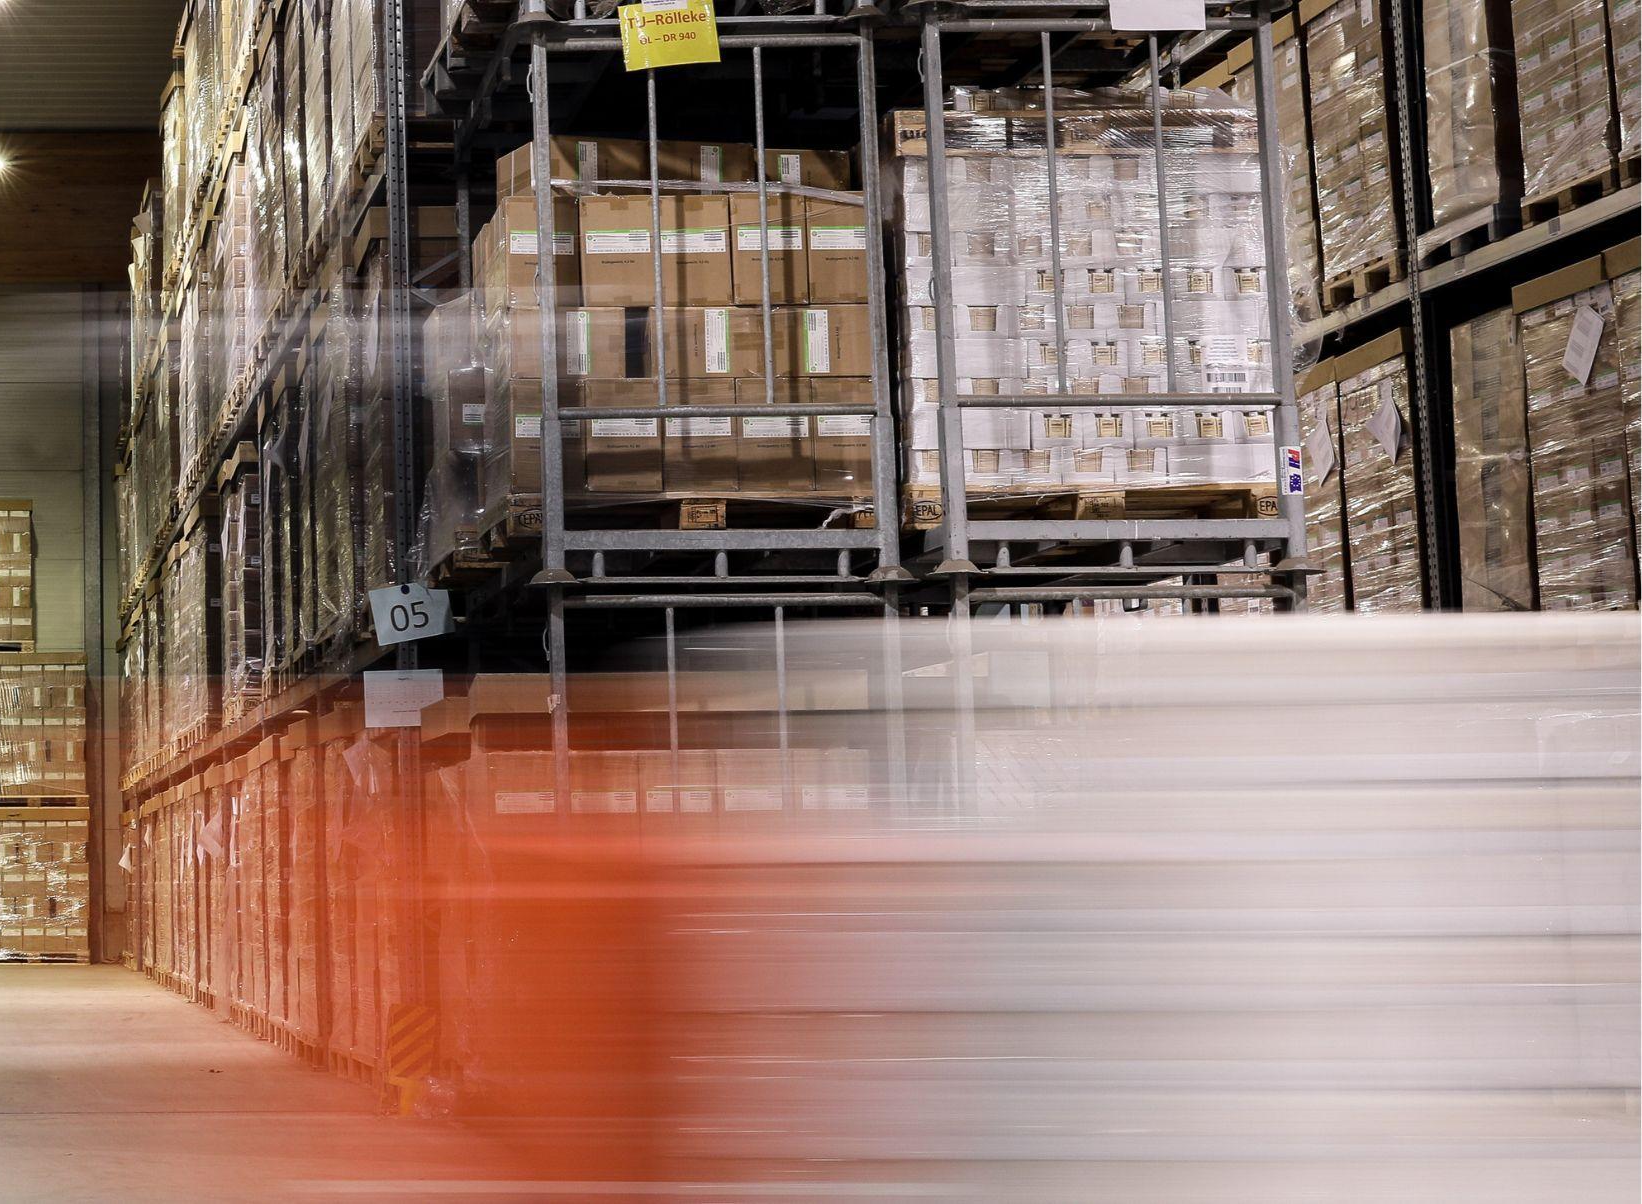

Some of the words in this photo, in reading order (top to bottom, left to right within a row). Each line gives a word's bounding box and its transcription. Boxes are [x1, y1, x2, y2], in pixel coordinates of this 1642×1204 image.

[663, 33, 677, 42] DR
[678, 31, 696, 41] 940
[914, 504, 940, 516] EPAL
[1259, 501, 1278, 512] EPA
[524, 513, 543, 525] EPA
[390, 600, 429, 632] 05
